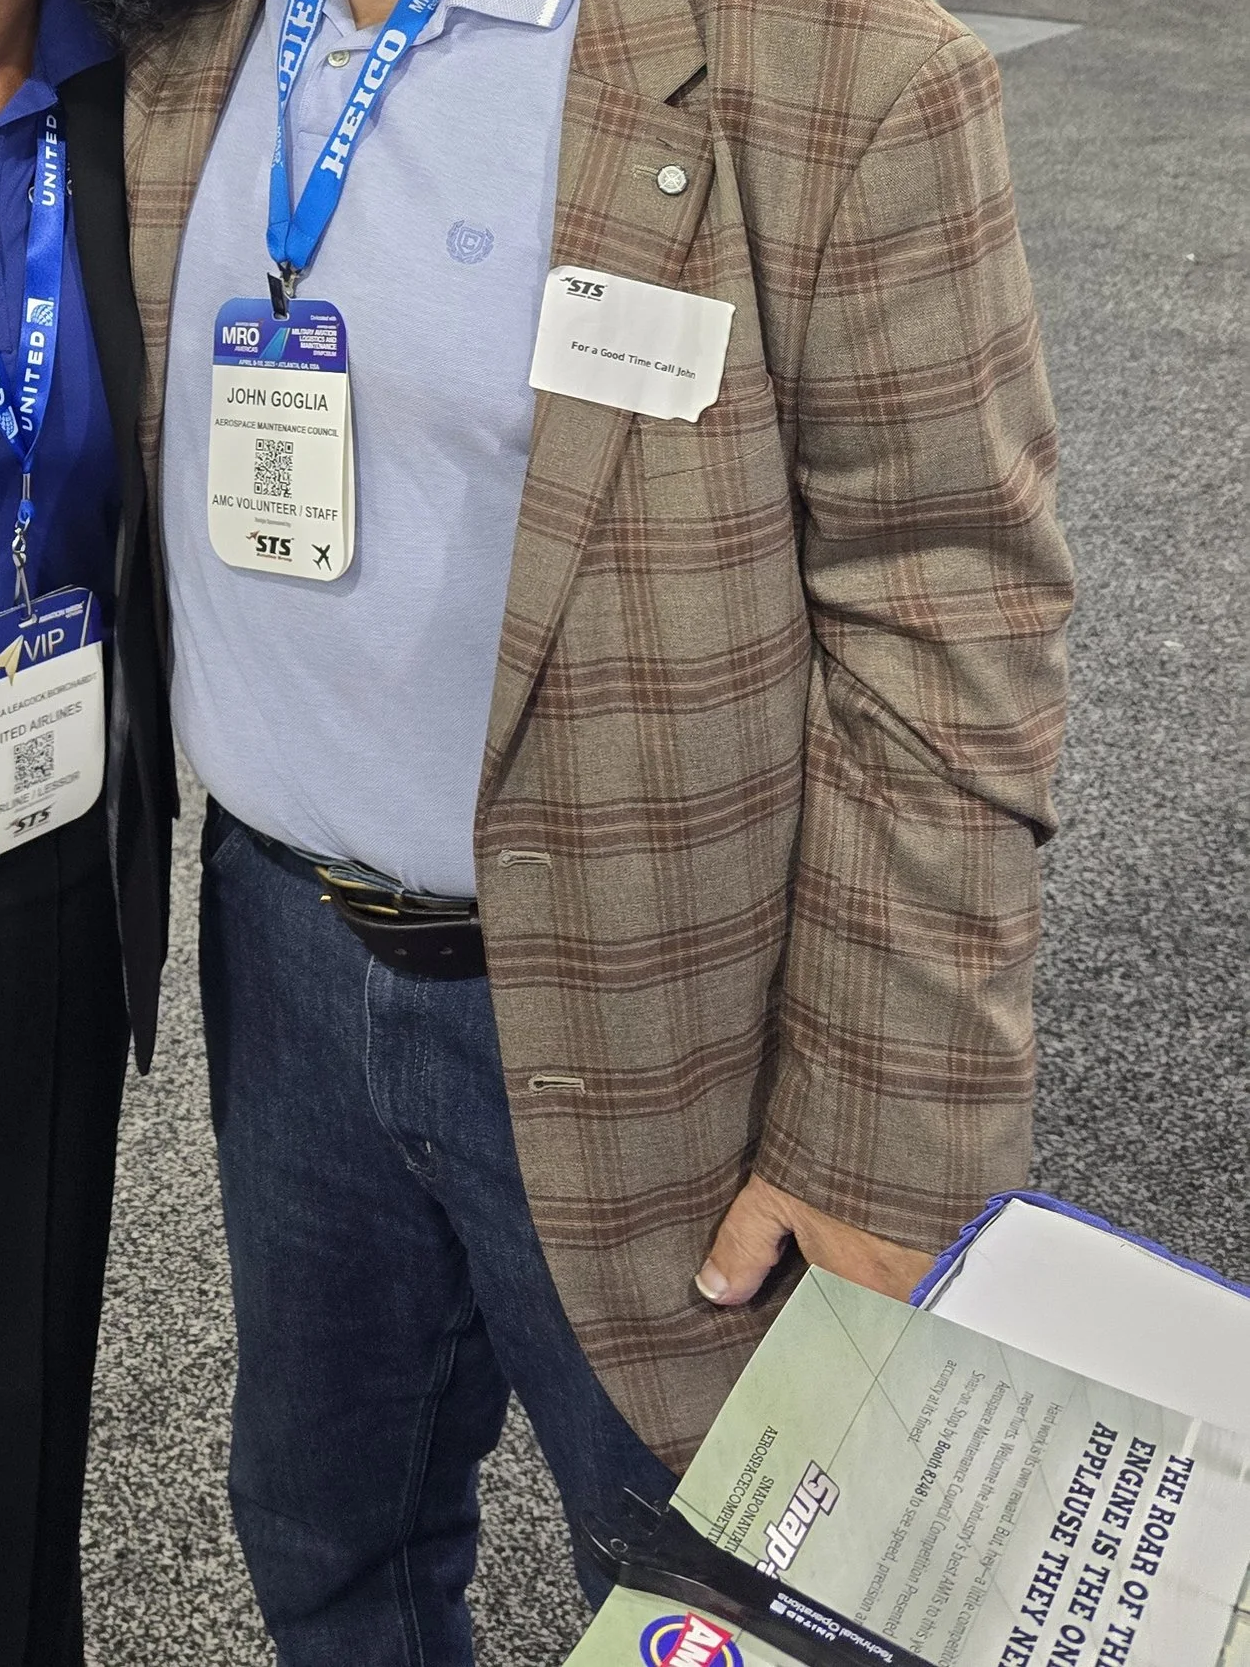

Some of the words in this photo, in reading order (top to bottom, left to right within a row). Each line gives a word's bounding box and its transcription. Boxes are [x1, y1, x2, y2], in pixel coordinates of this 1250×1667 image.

[320, 29, 407, 179] HEICO
[42, 115, 58, 206] UNITED
[567, 280, 605, 298] STS
[222, 326, 260, 346] MRO
[571, 340, 590, 353] For
[591, 347, 598, 355] a
[600, 348, 625, 362] Good
[628, 355, 652, 368] Time
[654, 362, 674, 374] Call
[676, 367, 696, 379] John
[20, 331, 46, 431] UNITED
[227, 388, 266, 406] JOHN
[271, 391, 328, 411] GOGLIA
[215, 418, 256, 430] AEROSPACE
[257, 421, 306, 434] MAINTENANCE
[307, 427, 339, 437] COUNCIL
[212, 494, 234, 507] AMC
[236, 497, 297, 516] VOLUNTEER
[305, 506, 338, 521] STAFF
[255, 535, 291, 556] STS
[24, 628, 65, 661] VIP
[30, 701, 83, 732] AIRLINES
[14, 806, 52, 834] STS
[930, 1360, 955, 1394] accuracy
[958, 1370, 982, 1409] Snap-on.
[921, 1404, 934, 1417] its
[928, 1394, 938, 1404] at
[980, 1381, 1008, 1425] Aerospace
[1014, 1391, 1032, 1418] never
[1044, 1403, 1061, 1424] Hard
[907, 1416, 929, 1445] finest.
[946, 1407, 964, 1430] Stop
[1005, 1416, 1023, 1442] hurts.
[940, 1428, 955, 1442] by
[1030, 1445, 1042, 1455] is
[1033, 1423, 1052, 1447] work
[927, 1440, 948, 1470] Booth
[953, 1424, 988, 1484] Maintenance
[985, 1441, 1012, 1485] Welcome
[1025, 1454, 1038, 1468] its
[915, 1469, 935, 1497] 8248
[978, 1484, 993, 1502] the
[1016, 1468, 1030, 1487] own
[1049, 1421, 1119, 1548] APPLAUSE
[1101, 1435, 1156, 1530] ENGINE
[1154, 1451, 1194, 1504] THE
[901, 1508, 914, 1527] see
[910, 1497, 921, 1508] to
[936, 1483, 961, 1521] Council
[1000, 1488, 1023, 1526] reward.
[954, 1500, 985, 1552] industry's
[989, 1526, 1007, 1548] But,
[1129, 1502, 1177, 1577] ROAR
[882, 1525, 908, 1565] speed,
[907, 1521, 945, 1584] Competition
[1089, 1528, 1122, 1561] IS
[945, 1552, 963, 1576] best
[860, 1563, 890, 1614] precision
[932, 1575, 953, 1606] AMTs
[963, 1585, 981, 1611] little
[1018, 1548, 1069, 1626] THEY
[1067, 1560, 1110, 1622] THE
[1114, 1578, 1151, 1620] OF
[776, 1592, 841, 1633] Operations
[784, 1608, 836, 1642] UNITED
[882, 1583, 916, 1638] Presented
[926, 1605, 938, 1617] to
[917, 1617, 934, 1640] this
[1046, 1621, 1088, 1667] ON
[1094, 1621, 1135, 1667] TH
[837, 1626, 895, 1664] Technical
[997, 1625, 1038, 1667] NE
